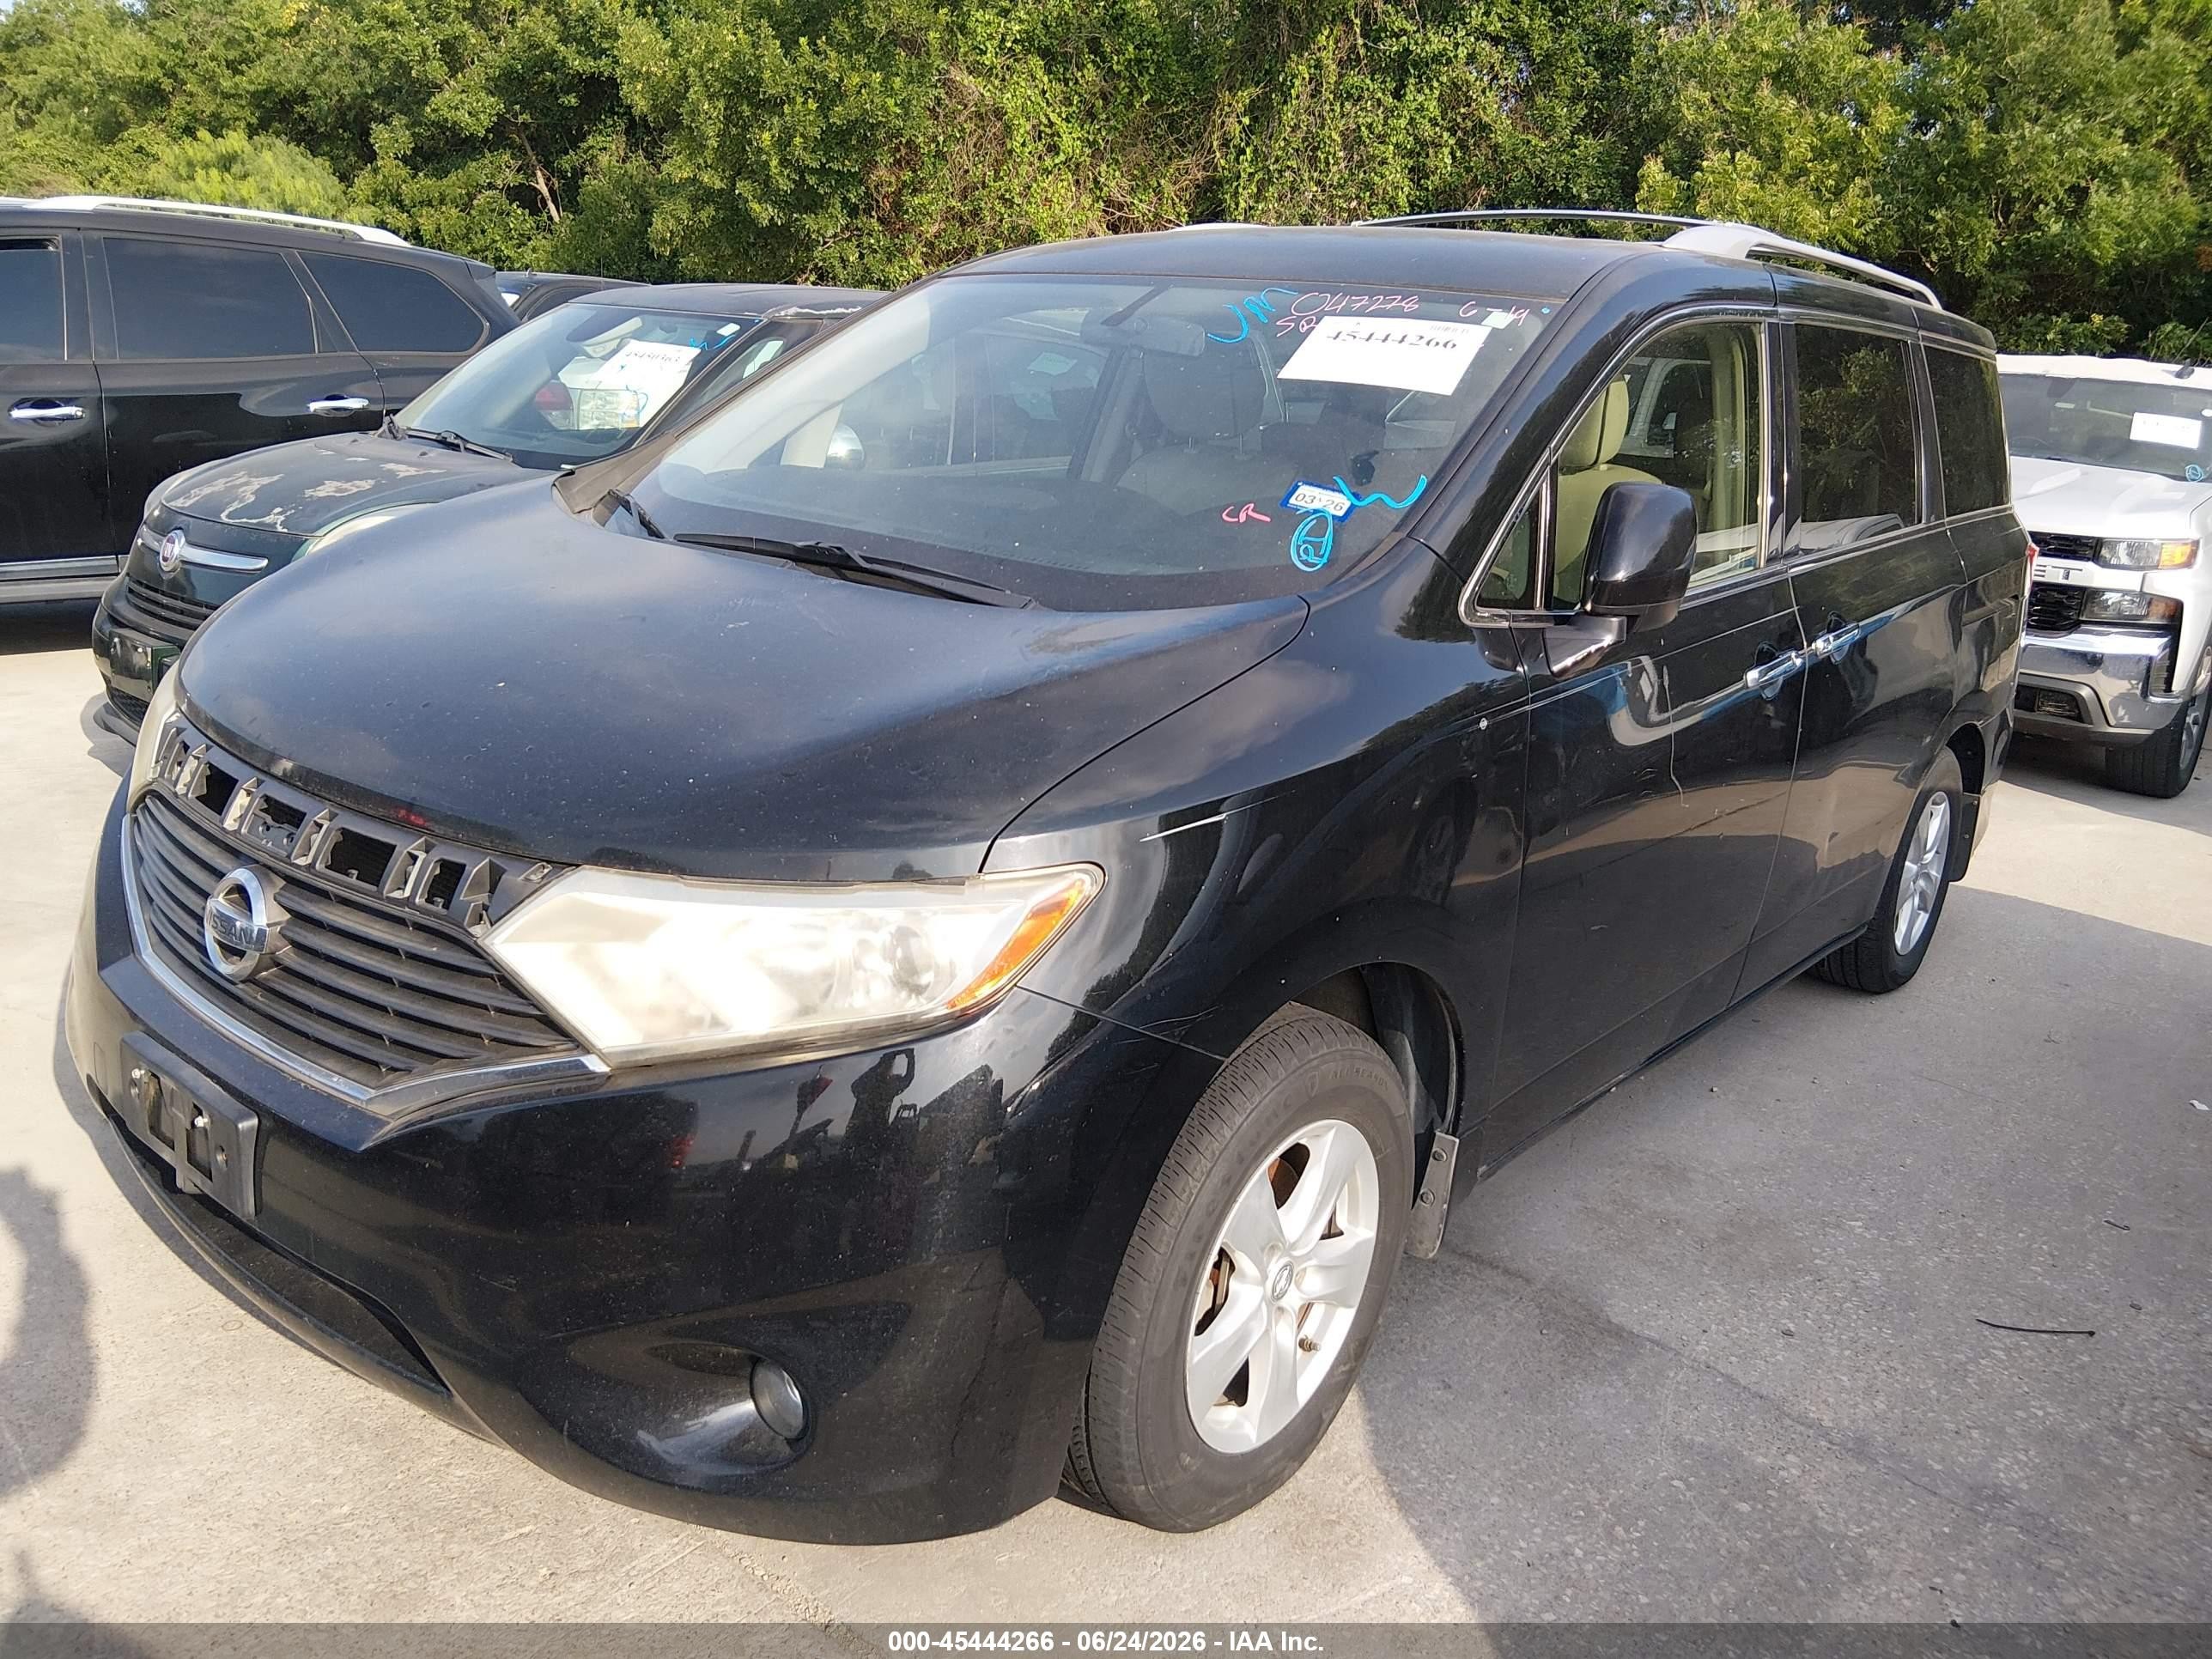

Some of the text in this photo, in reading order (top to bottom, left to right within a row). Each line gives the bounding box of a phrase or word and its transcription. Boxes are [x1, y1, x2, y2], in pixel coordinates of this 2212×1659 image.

[1326, 329, 1458, 350] 45444266
[1294, 492, 1346, 512] 03 26
